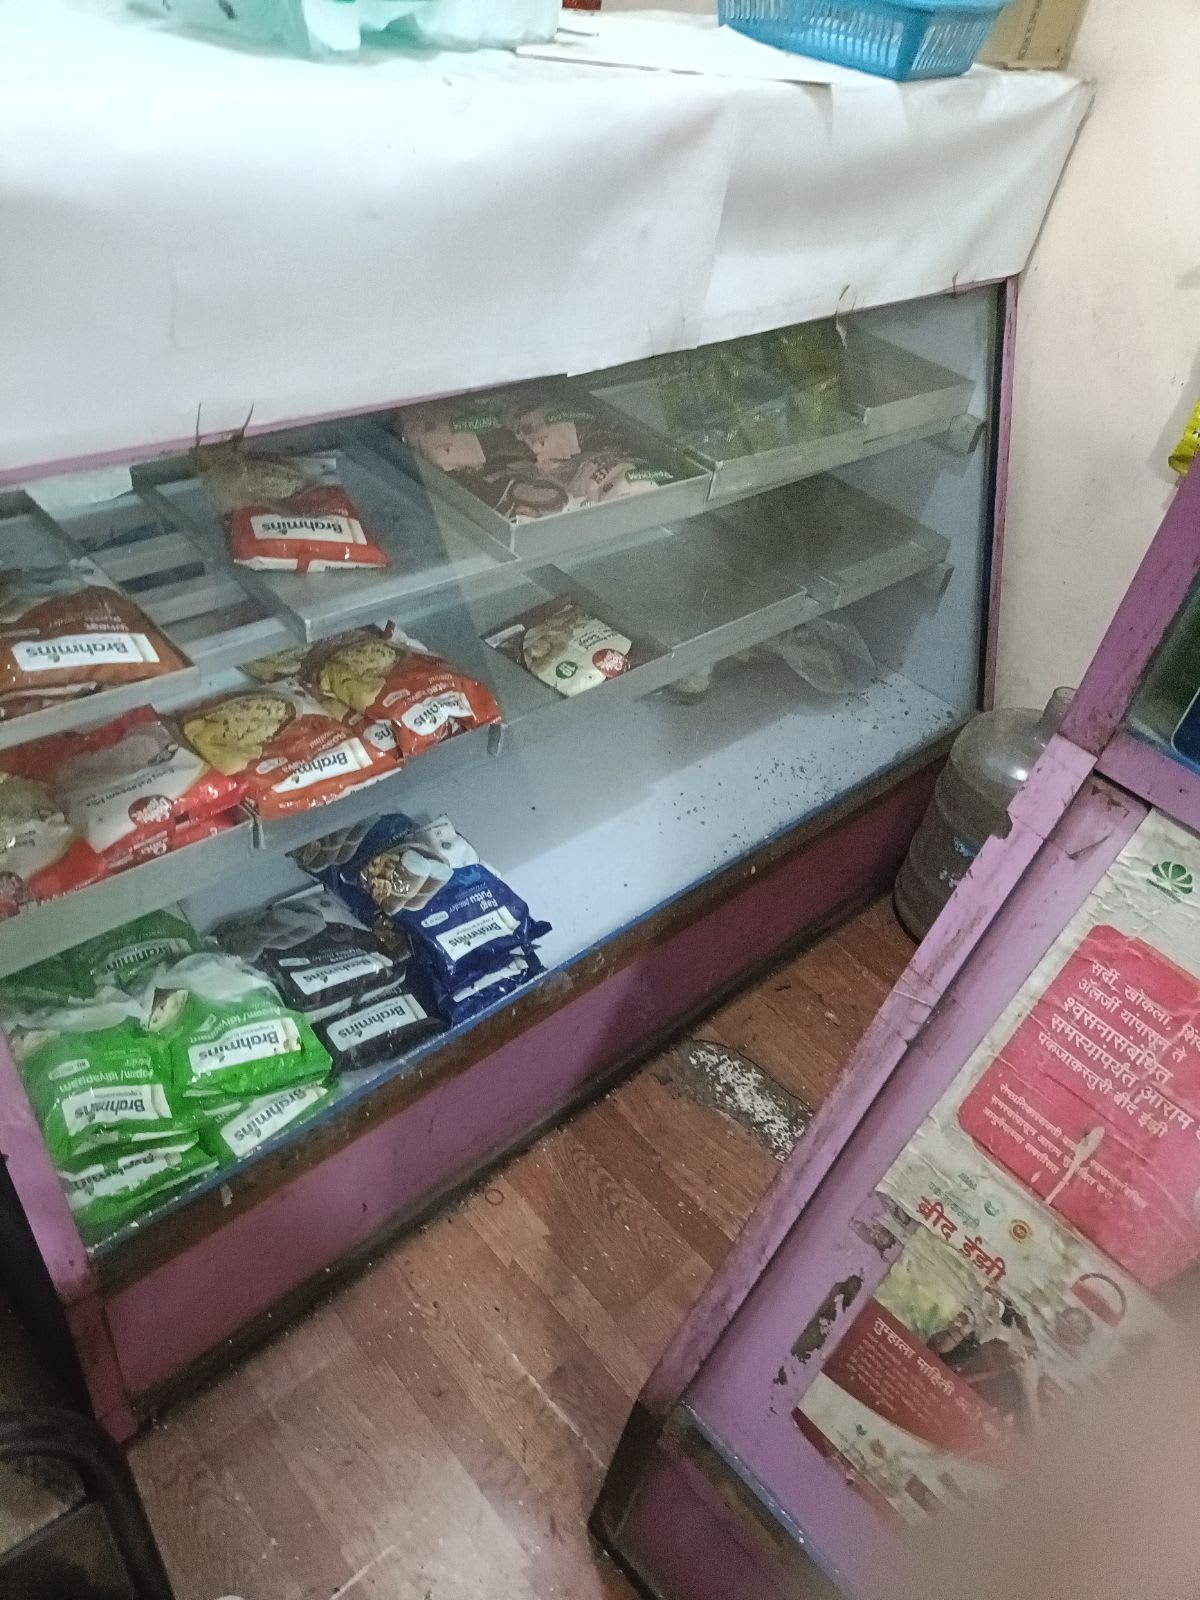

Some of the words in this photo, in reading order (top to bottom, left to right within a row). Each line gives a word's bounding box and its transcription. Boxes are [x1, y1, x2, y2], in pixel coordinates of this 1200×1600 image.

[261, 522, 343, 535] Brahmins
[25, 641, 129, 663] Brahmins
[469, 888, 494, 903] Puttu
[479, 897, 498, 912] Ragi
[448, 921, 502, 948] Brahmins
[302, 958, 372, 985] Brahmins
[337, 1004, 406, 1039] Brahmins
[1123, 983, 1173, 1032] खोकला,
[198, 1030, 279, 1063] Brahmins
[1062, 995, 1175, 1085] श्वसनासंबंधित
[1118, 1009, 1171, 1052] यांपासून
[1171, 1047, 1187, 1064] ते
[1048, 1013, 1140, 1089] समस्यांपर्यंत
[1140, 1084, 1195, 1130] आराम
[74, 1099, 146, 1120] Brahmins
[233, 1087, 307, 1142] Brahmins
[872, 1317, 917, 1359] तुम्हाला
